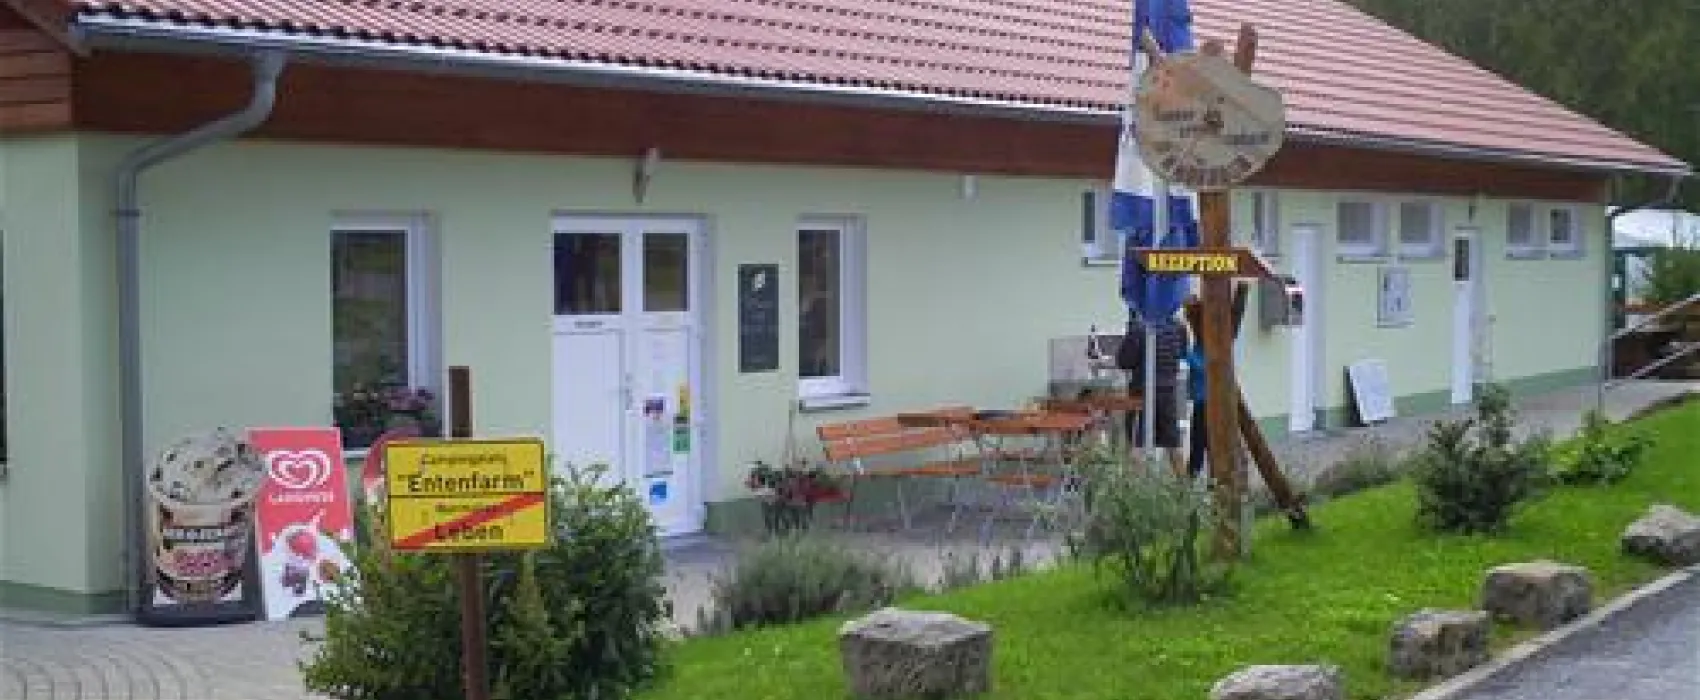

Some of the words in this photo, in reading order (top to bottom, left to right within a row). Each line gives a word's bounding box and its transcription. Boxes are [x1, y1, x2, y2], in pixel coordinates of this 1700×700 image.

[1147, 252, 1239, 272] RECEPTION
[397, 470, 535, 493] "Entenfarm"
[434, 524, 504, 541] Leben
